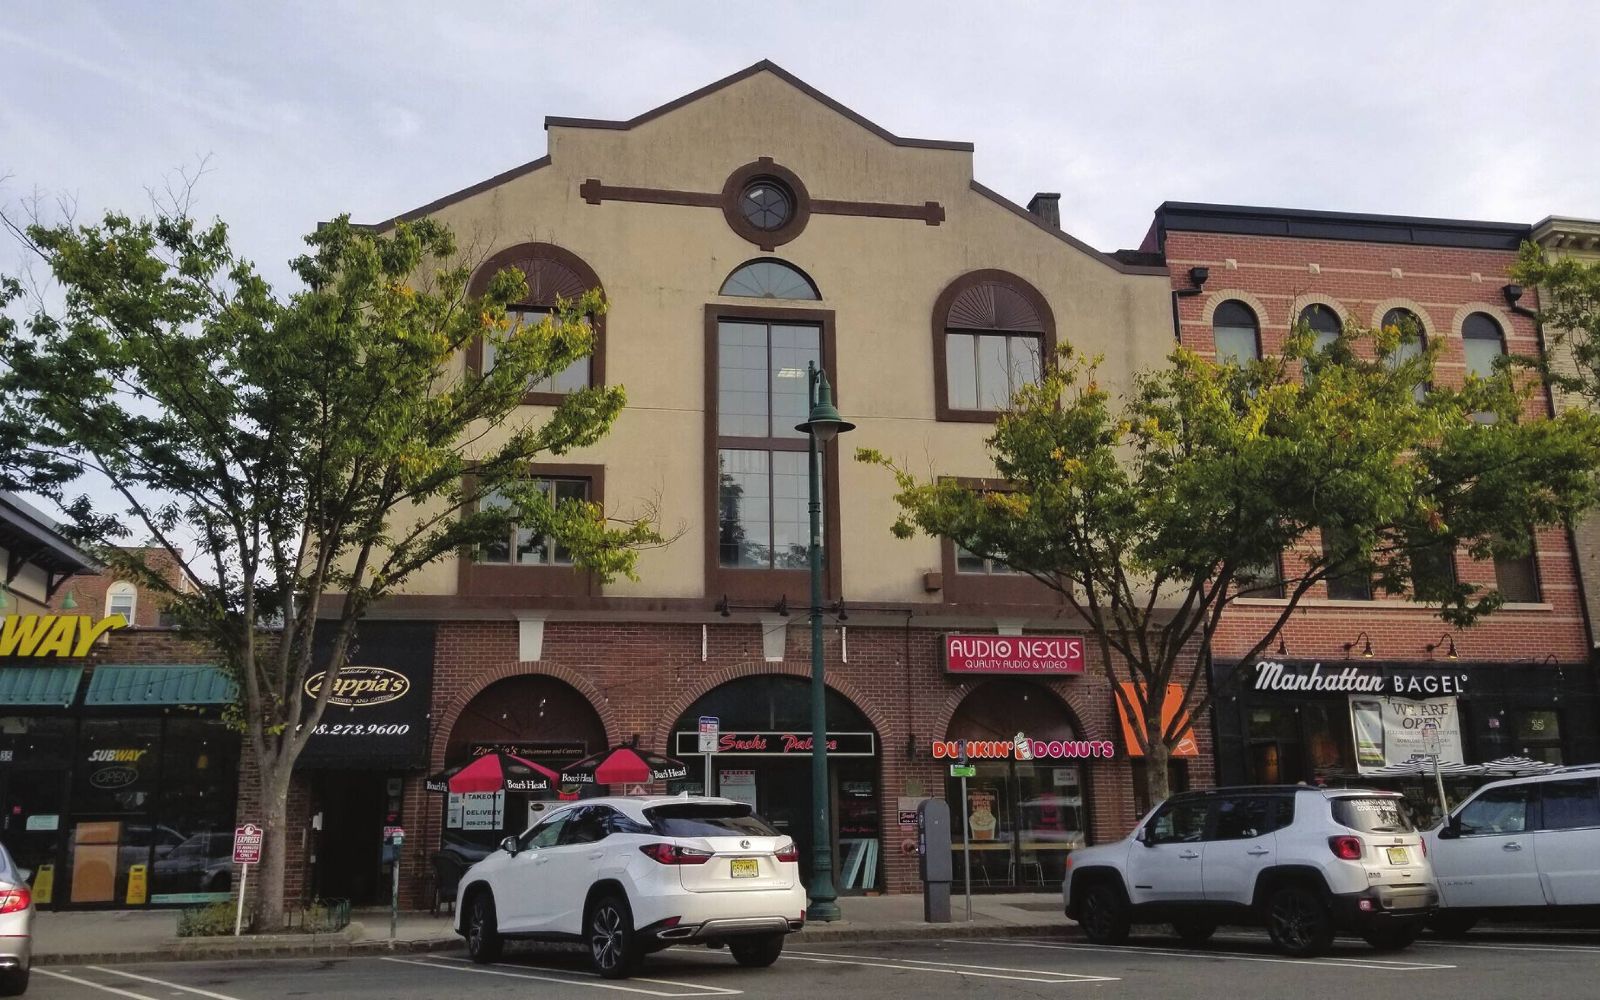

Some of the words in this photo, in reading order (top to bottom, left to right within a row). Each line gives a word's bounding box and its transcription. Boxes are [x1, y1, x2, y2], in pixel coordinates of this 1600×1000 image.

[0, 612, 128, 658] WAY
[950, 639, 1012, 658] AUDIO
[1018, 640, 1080, 659] NEXUS
[964, 659, 1001, 669] QUALITY
[1002, 660, 1030, 669] AUDIO
[1033, 660, 1040, 669] &
[1255, 661, 1385, 691] Manhattan
[310, 674, 405, 697] Zppia's
[1392, 703, 1417, 716] WE
[1421, 703, 1449, 716] ARE
[1402, 717, 1442, 729] OPEN
[295, 724, 409, 735] 8.273.9600
[718, 733, 767, 752] Sushi
[780, 733, 838, 753] Palce
[88, 750, 147, 761] SUBWAY
[1033, 741, 1115, 759] DONUTS
[96, 770, 130, 784] OPEN
[668, 766, 687, 778] Head
[507, 780, 525, 789] Boar's
[527, 780, 547, 789] Head
[581, 774, 594, 783] Head
[236, 836, 260, 844] EXPRESS
